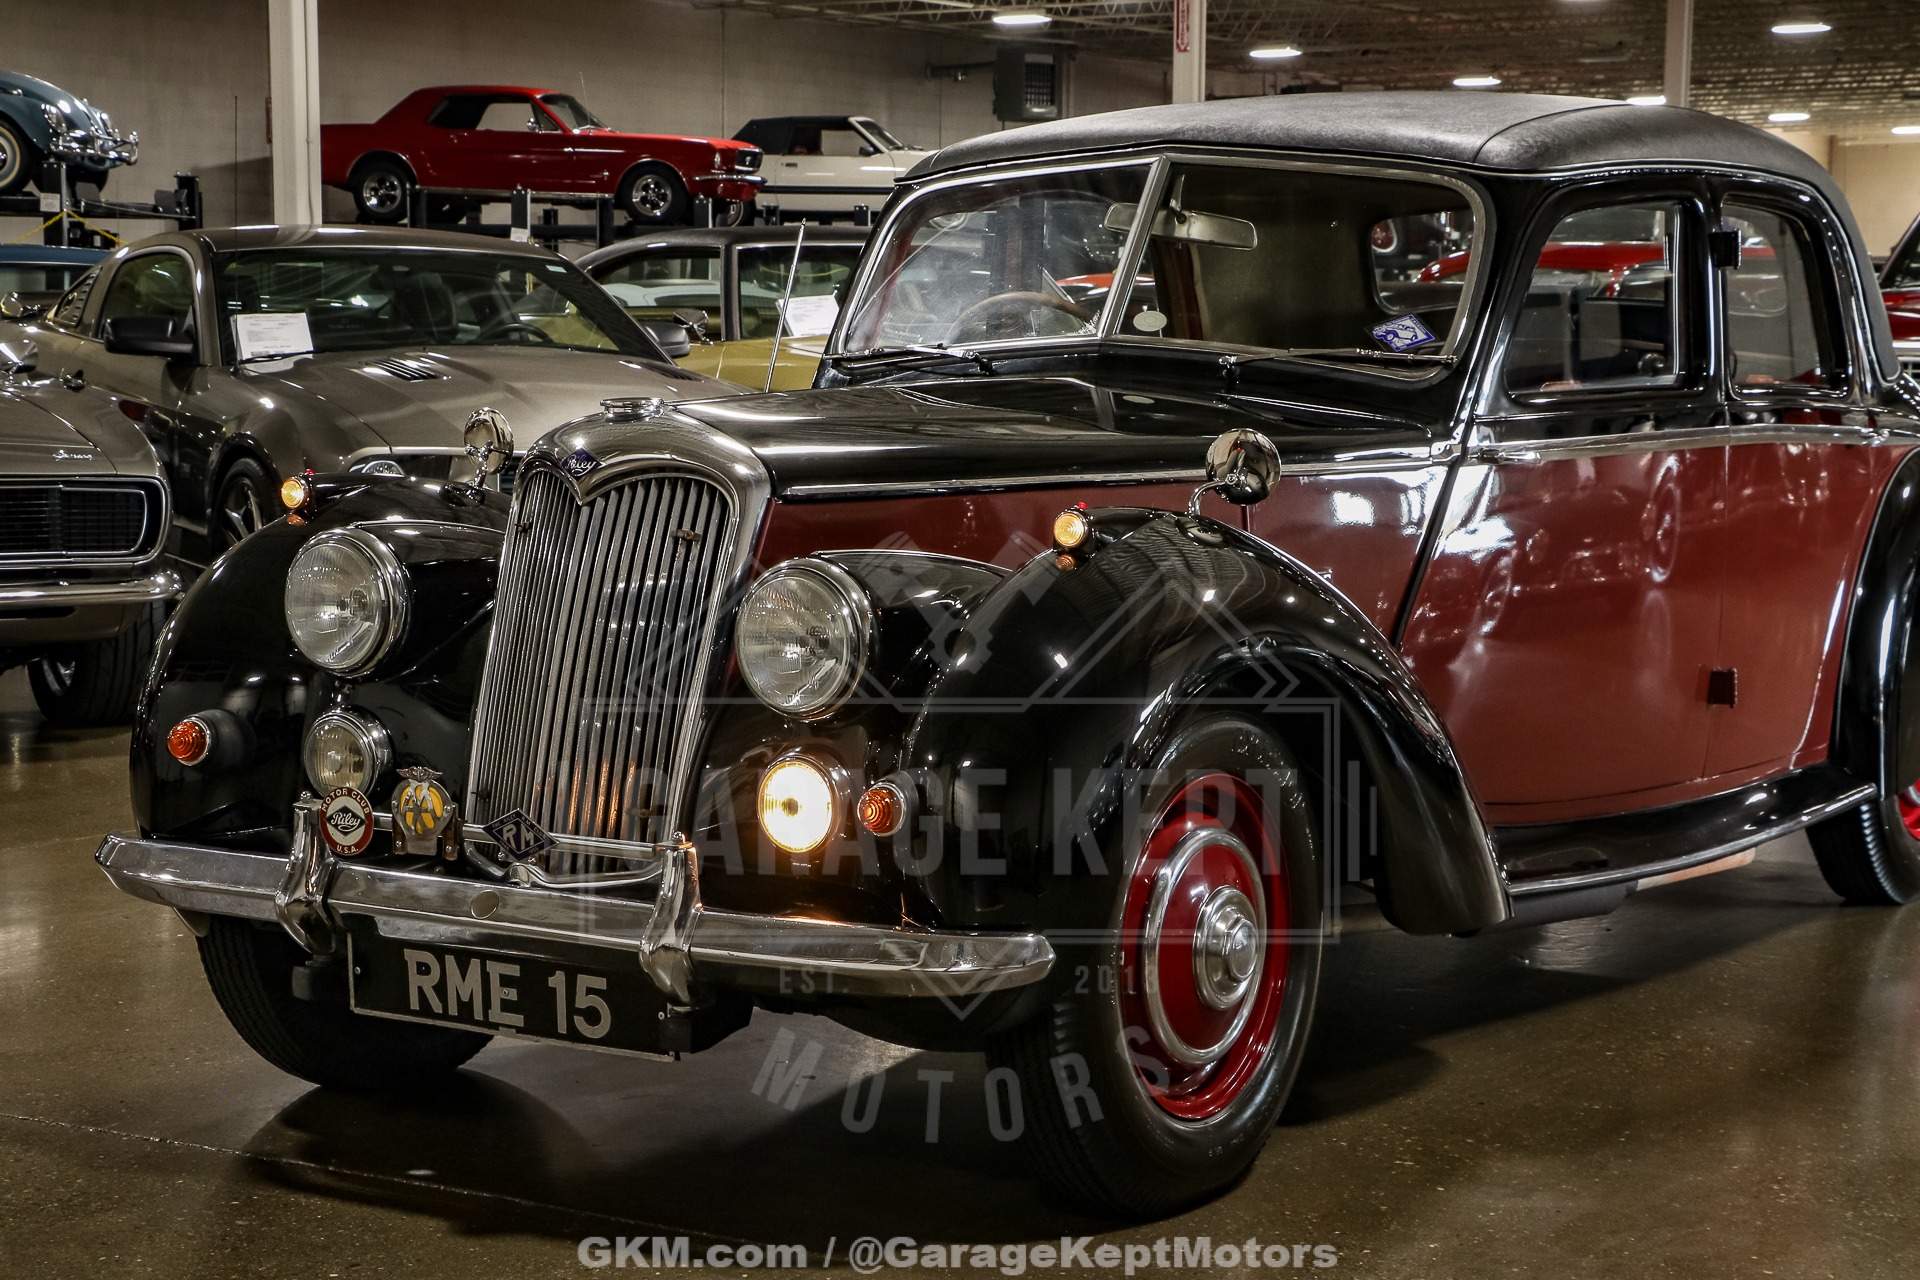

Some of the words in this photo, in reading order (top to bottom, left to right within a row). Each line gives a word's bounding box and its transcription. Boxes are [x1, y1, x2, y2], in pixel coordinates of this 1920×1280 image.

[564, 453, 597, 477] Riley
[321, 788, 348, 812] MOTOR
[351, 791, 370, 814] CLUB
[330, 811, 361, 832] Riley
[533, 827, 546, 838] CLUB
[502, 822, 535, 851] RM
[336, 844, 359, 854] U.S.A.
[404, 949, 525, 1027] RME
[548, 970, 611, 1039] 15
